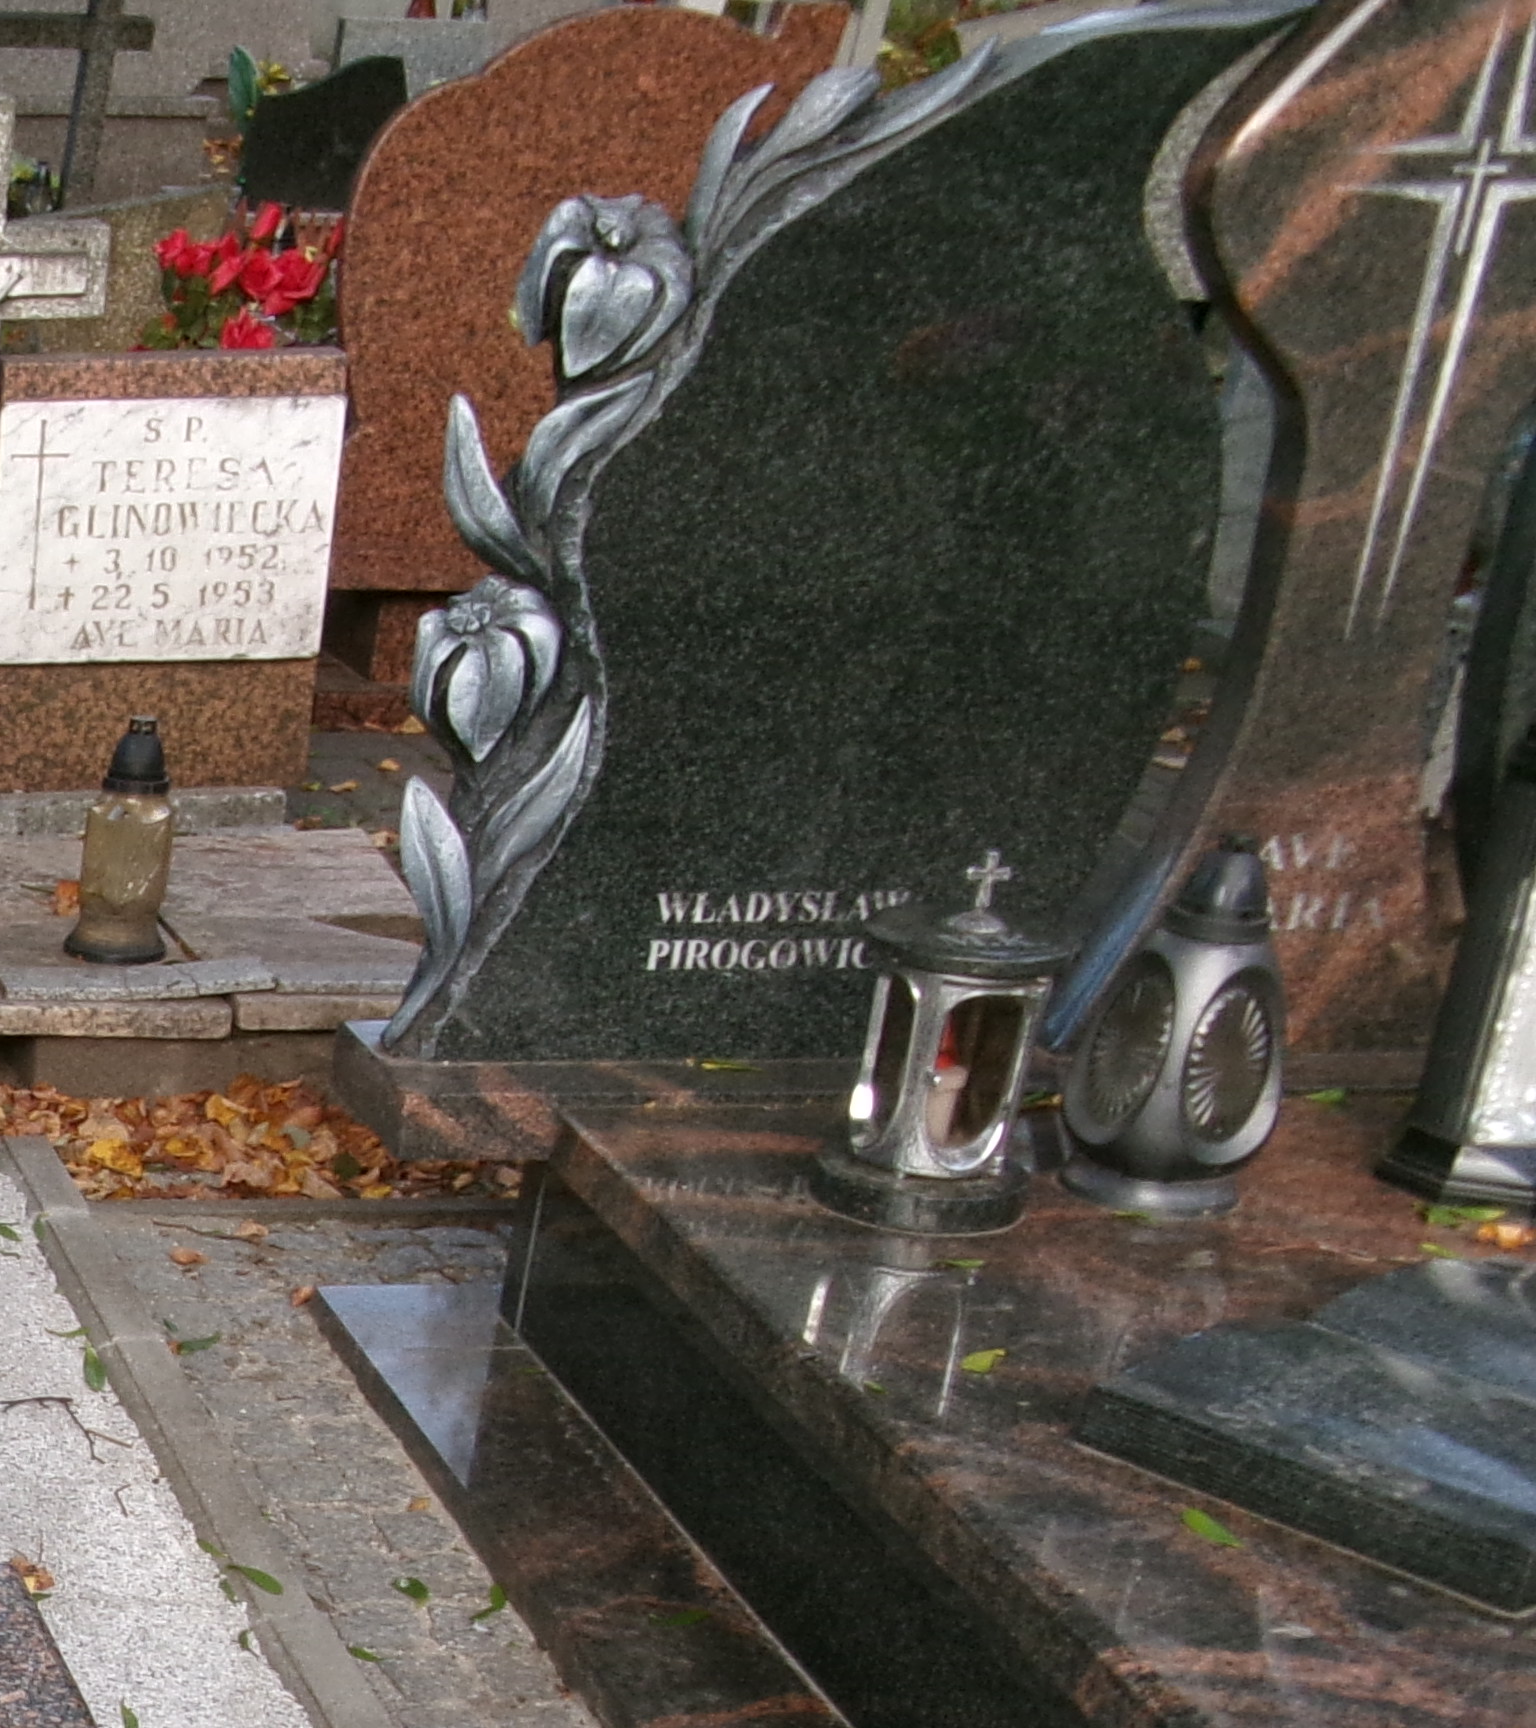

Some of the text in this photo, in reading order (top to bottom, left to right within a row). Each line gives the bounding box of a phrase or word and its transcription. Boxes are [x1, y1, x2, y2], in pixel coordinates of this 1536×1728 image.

[92, 456, 274, 494] TERESA
[147, 546, 178, 572] 10
[91, 583, 132, 611] 22
[151, 582, 170, 609] 5
[70, 617, 268, 650] AVE MARIA
[646, 938, 874, 971] PIROGOWIC
